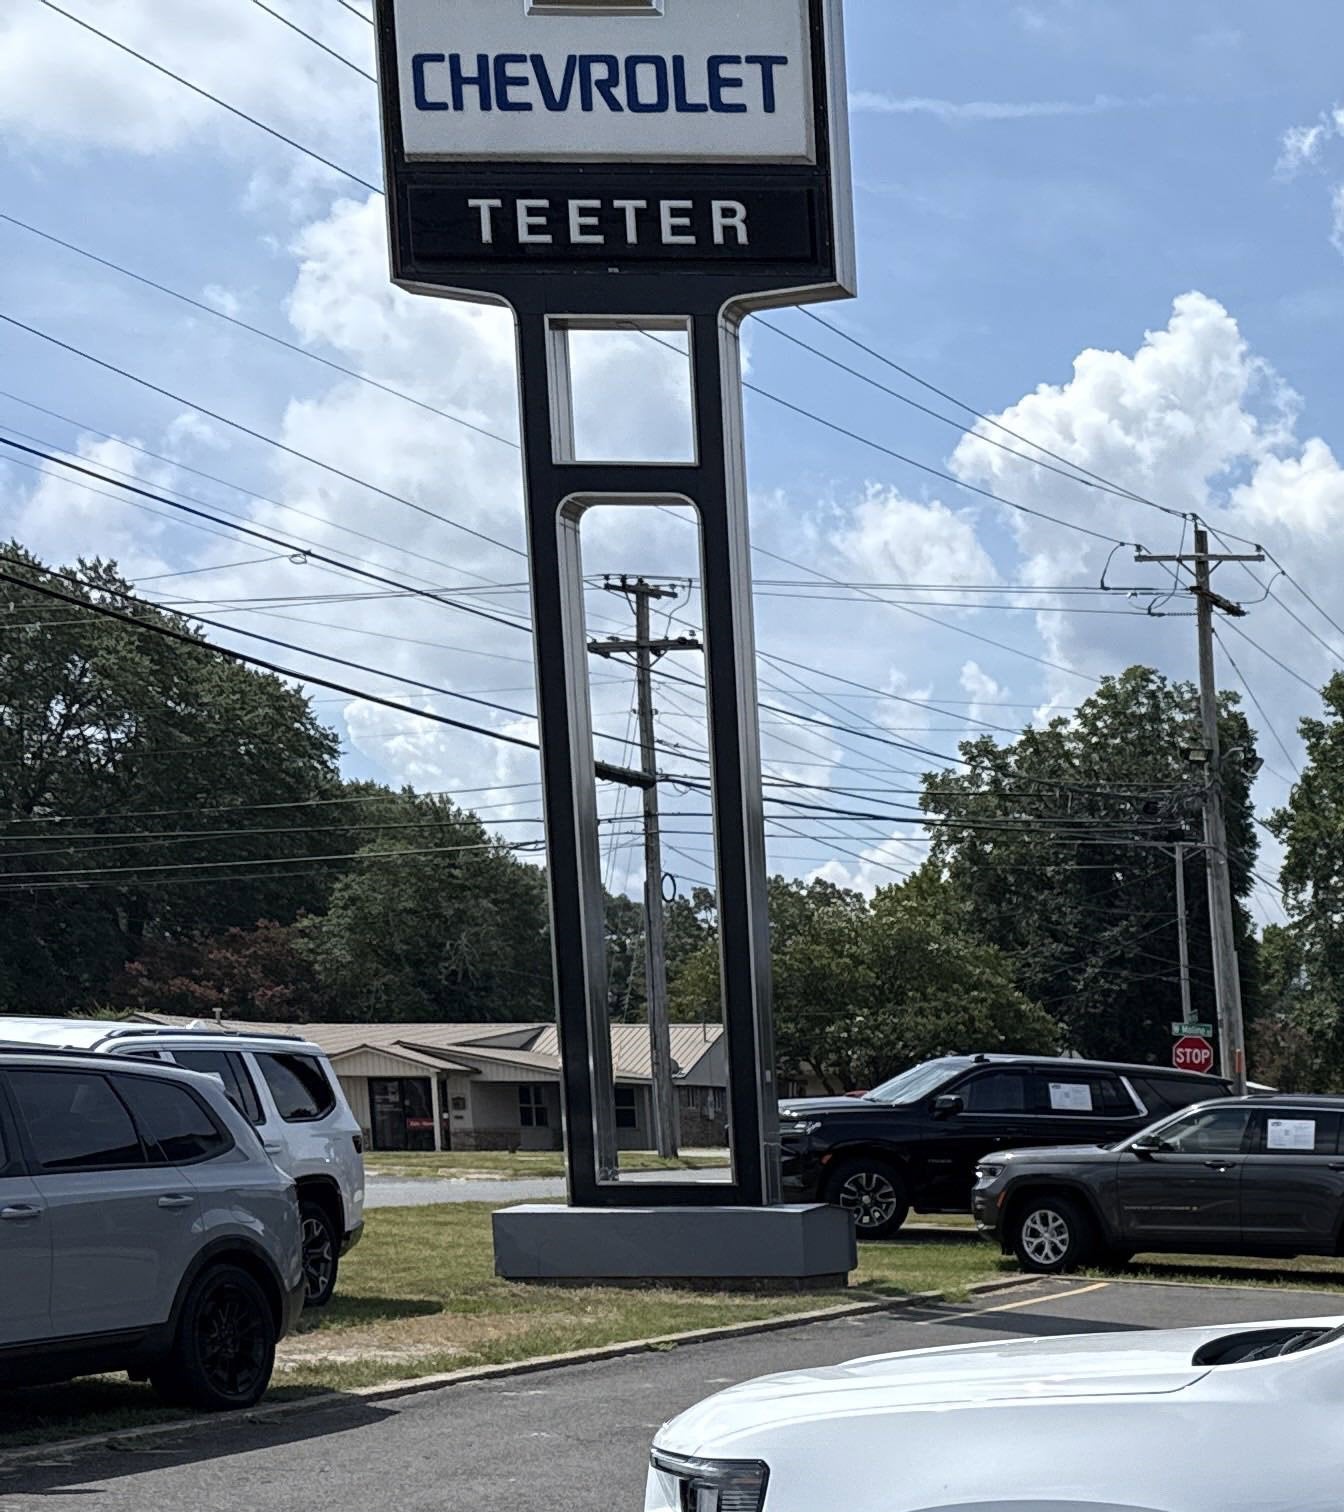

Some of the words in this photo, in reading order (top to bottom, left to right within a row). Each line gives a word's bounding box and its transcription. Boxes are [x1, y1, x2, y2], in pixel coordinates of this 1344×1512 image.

[411, 54, 788, 113] CHEVROLET
[468, 198, 750, 246] TEETER
[1176, 1048, 1210, 1064] STOP
